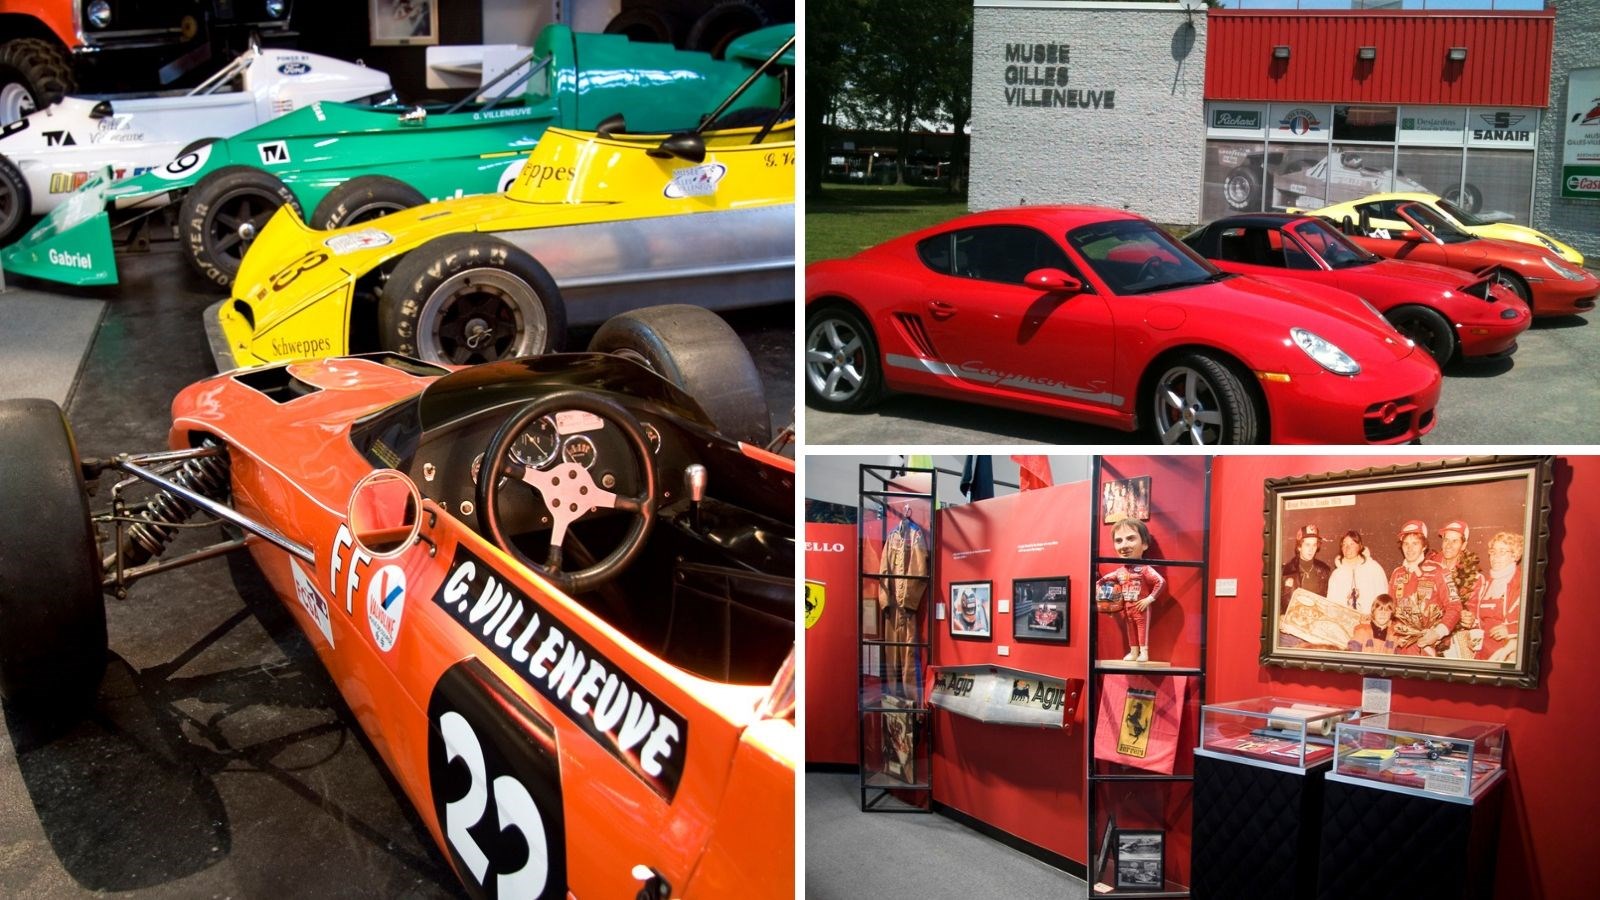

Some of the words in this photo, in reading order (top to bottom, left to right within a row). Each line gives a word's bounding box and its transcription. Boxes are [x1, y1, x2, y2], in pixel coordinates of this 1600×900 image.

[1004, 40, 1071, 64] MUSÉE
[283, 63, 305, 74] Ford
[1004, 65, 1070, 87] GILLES
[1004, 87, 1116, 110] VILLENEUVE
[483, 107, 532, 119] VILLENEUVE
[1216, 112, 1257, 127] Richard
[1473, 129, 1531, 142] SANAIR
[49, 248, 92, 270] Gabriel
[272, 337, 331, 357] Schweppes
[948, 672, 975, 696] Agip
